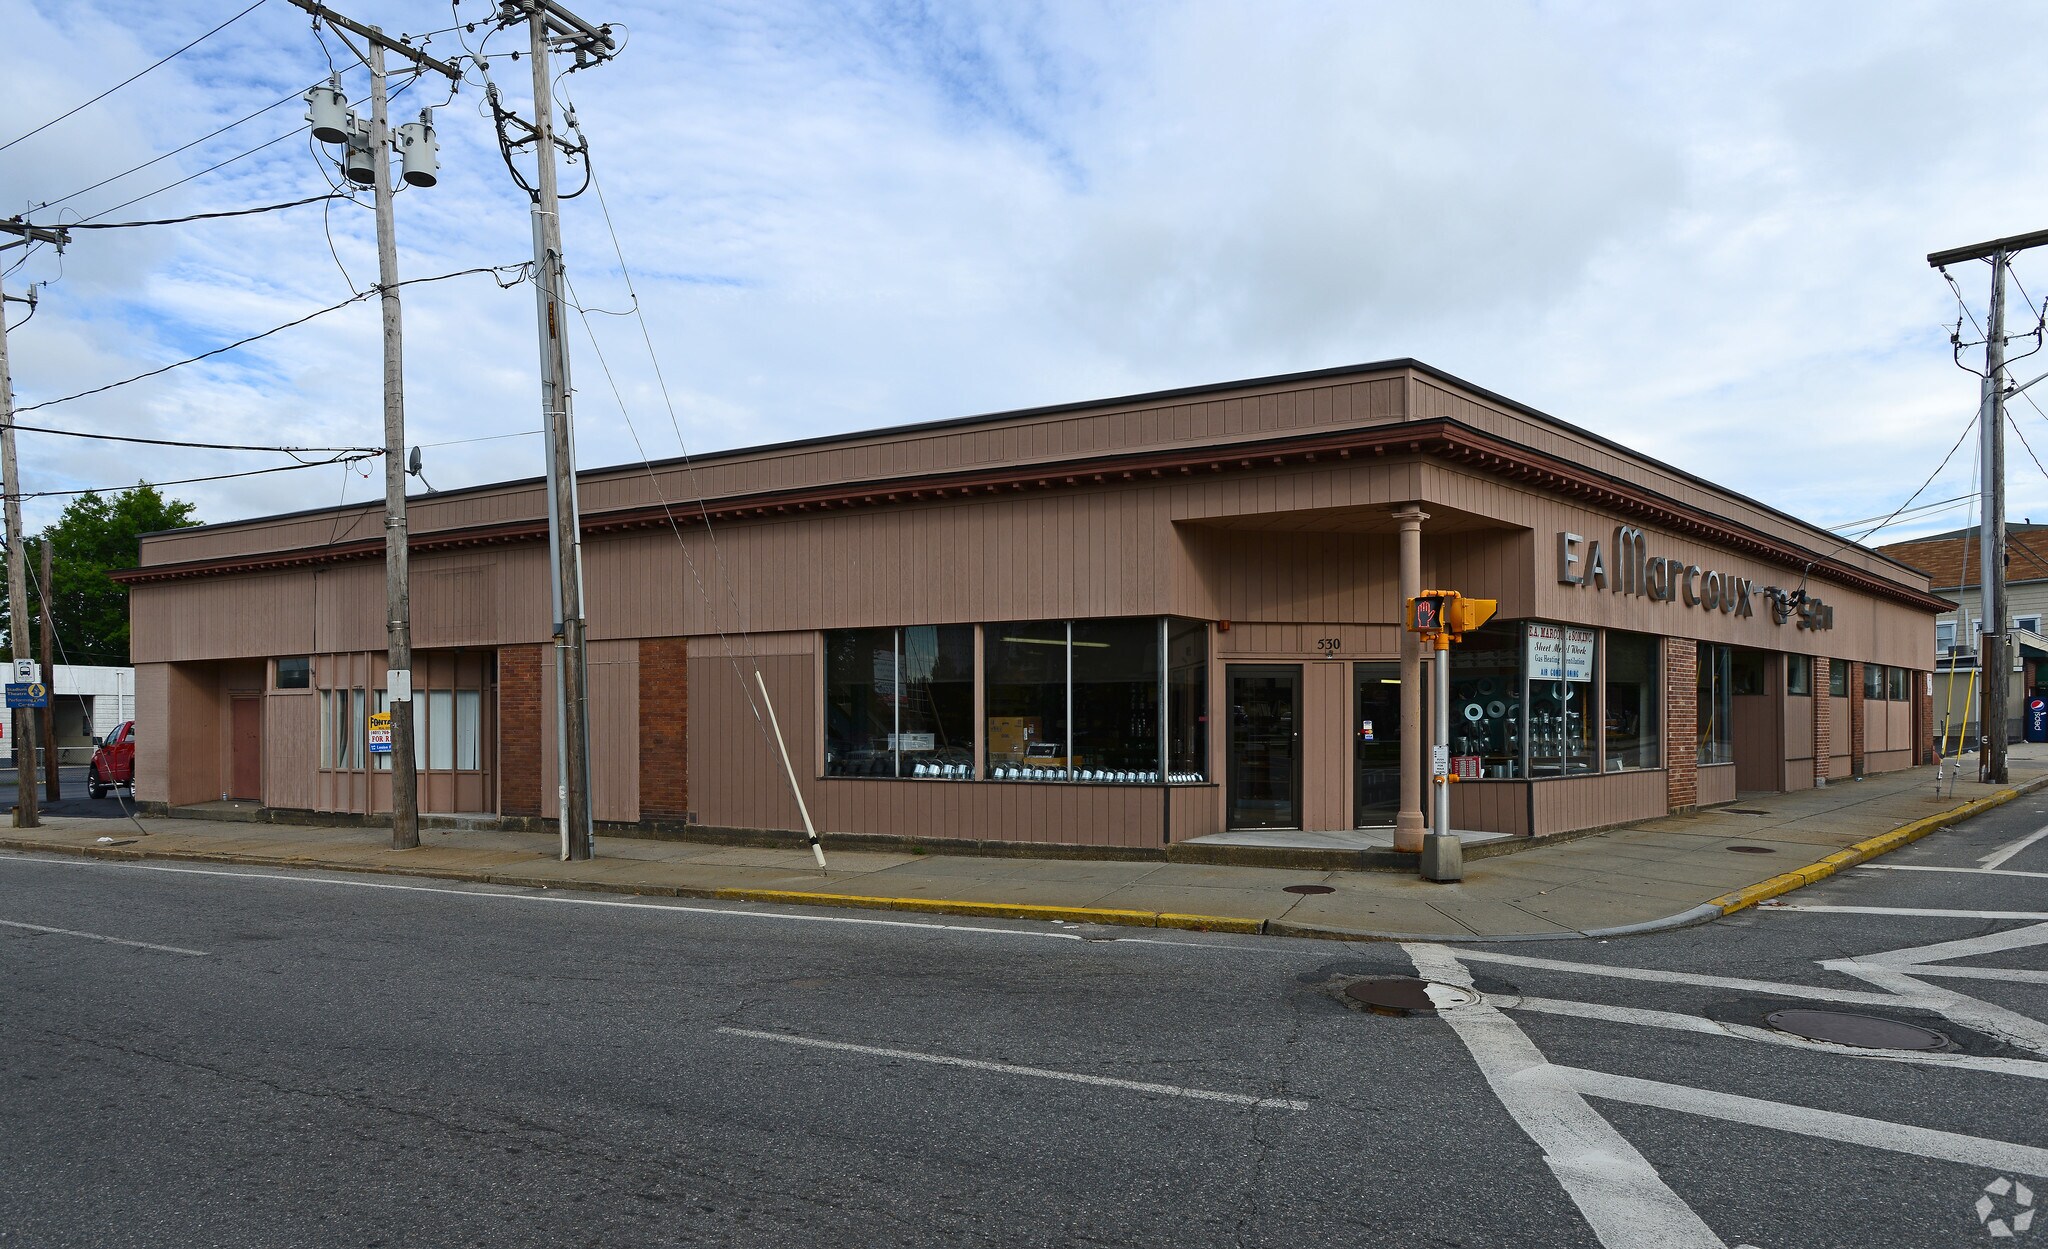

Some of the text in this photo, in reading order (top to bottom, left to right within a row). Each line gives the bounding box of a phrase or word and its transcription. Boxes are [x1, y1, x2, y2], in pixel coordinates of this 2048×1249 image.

[1612, 525, 1753, 618] Marcoux
[1540, 627, 1568, 640] MARCOU
[1317, 638, 1340, 650] 530
[1535, 641, 1587, 655] Sheet Mel Work
[1534, 653, 1585, 666] Gas Heating entilation
[1540, 668, 1548, 676] AIR
[1550, 669, 1579, 677] CONDONING
[2034, 711, 2042, 731] pepsi
